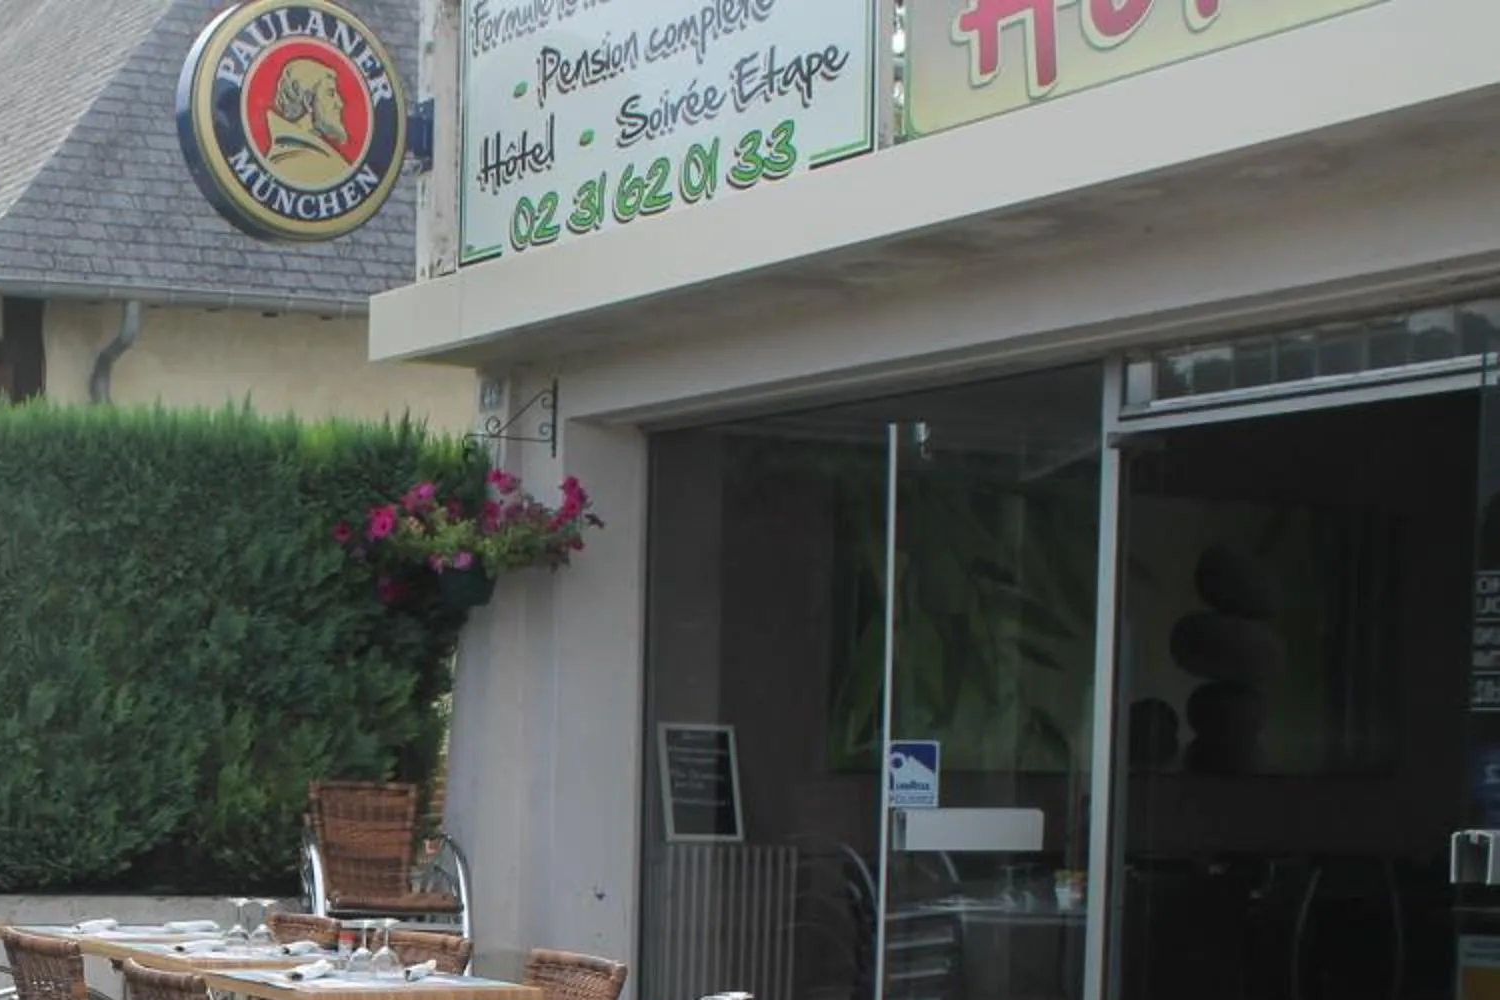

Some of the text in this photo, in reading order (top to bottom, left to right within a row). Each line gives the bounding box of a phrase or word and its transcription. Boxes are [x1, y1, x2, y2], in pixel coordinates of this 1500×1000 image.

[216, 8, 393, 106] PAULANER
[539, 31, 639, 105] Pension
[479, 44, 850, 191] Hôtel Soirée Etape
[229, 148, 379, 219] MÜNCHEN
[511, 119, 797, 249] 02 31 62 01 33
